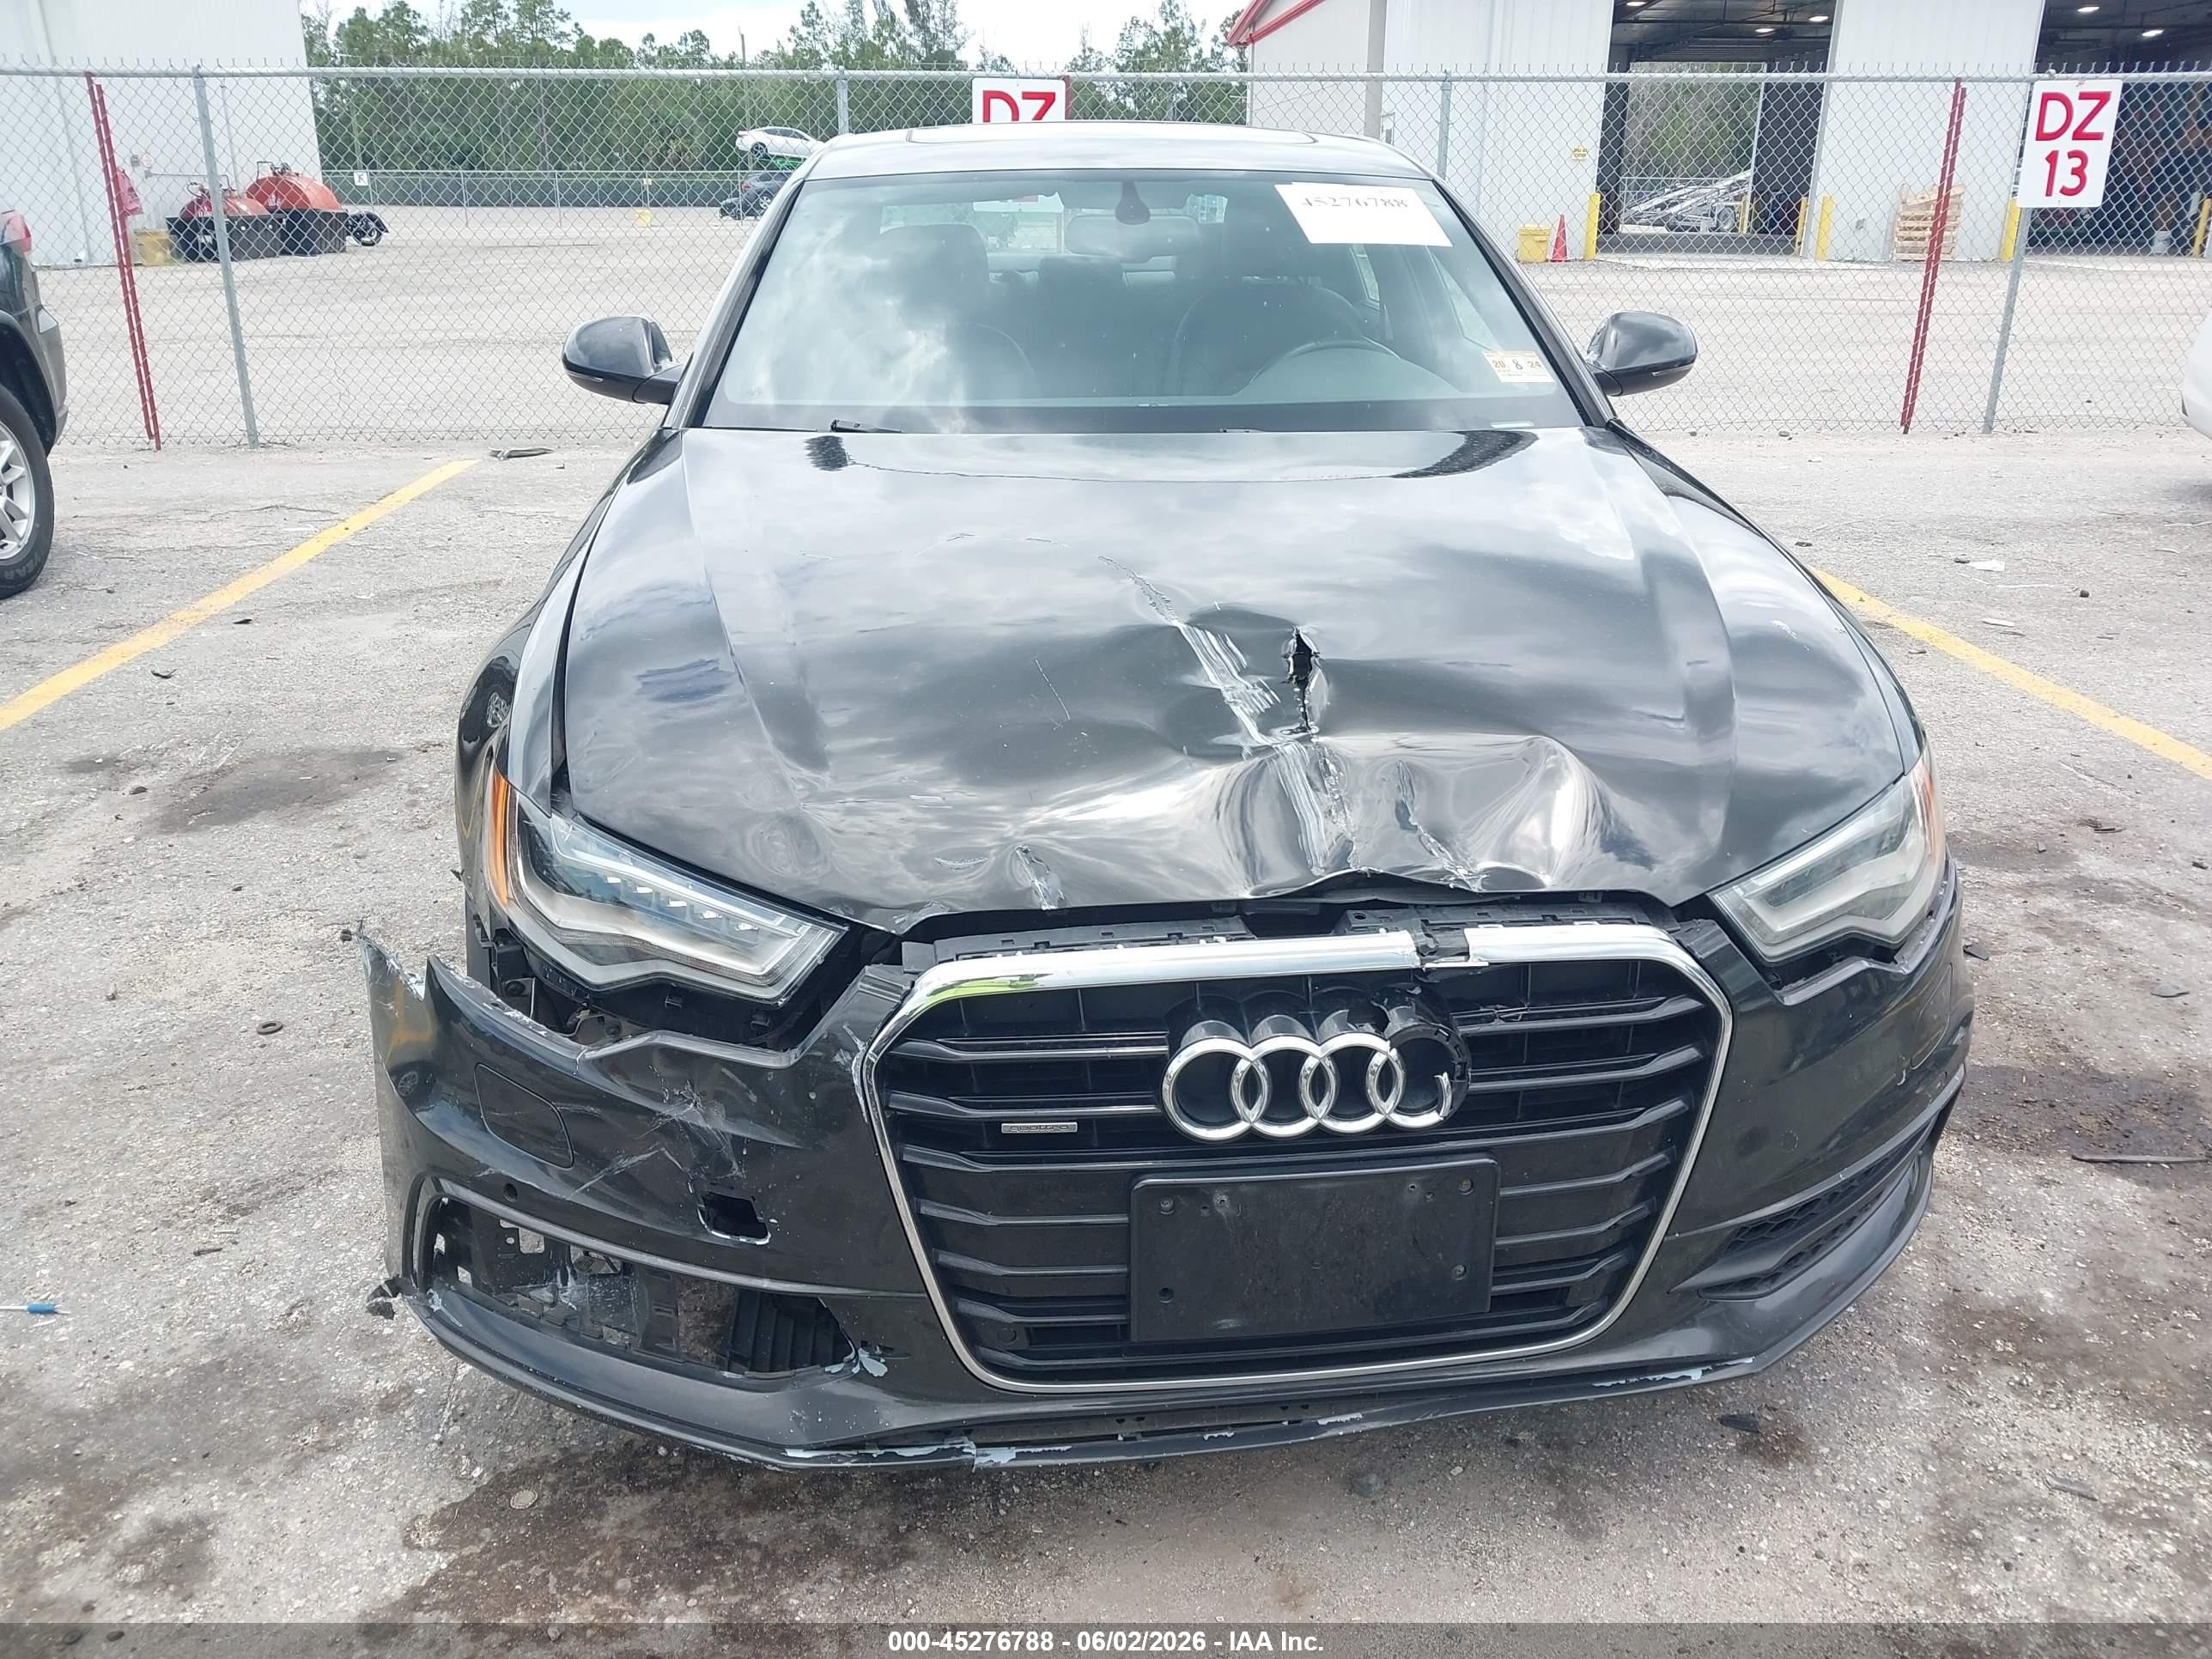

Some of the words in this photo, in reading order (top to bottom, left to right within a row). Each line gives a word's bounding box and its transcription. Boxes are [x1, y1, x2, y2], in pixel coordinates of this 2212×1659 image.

[982, 90, 1055, 122] DZ
[2035, 91, 2112, 141] DZ
[2045, 149, 2088, 197] 13
